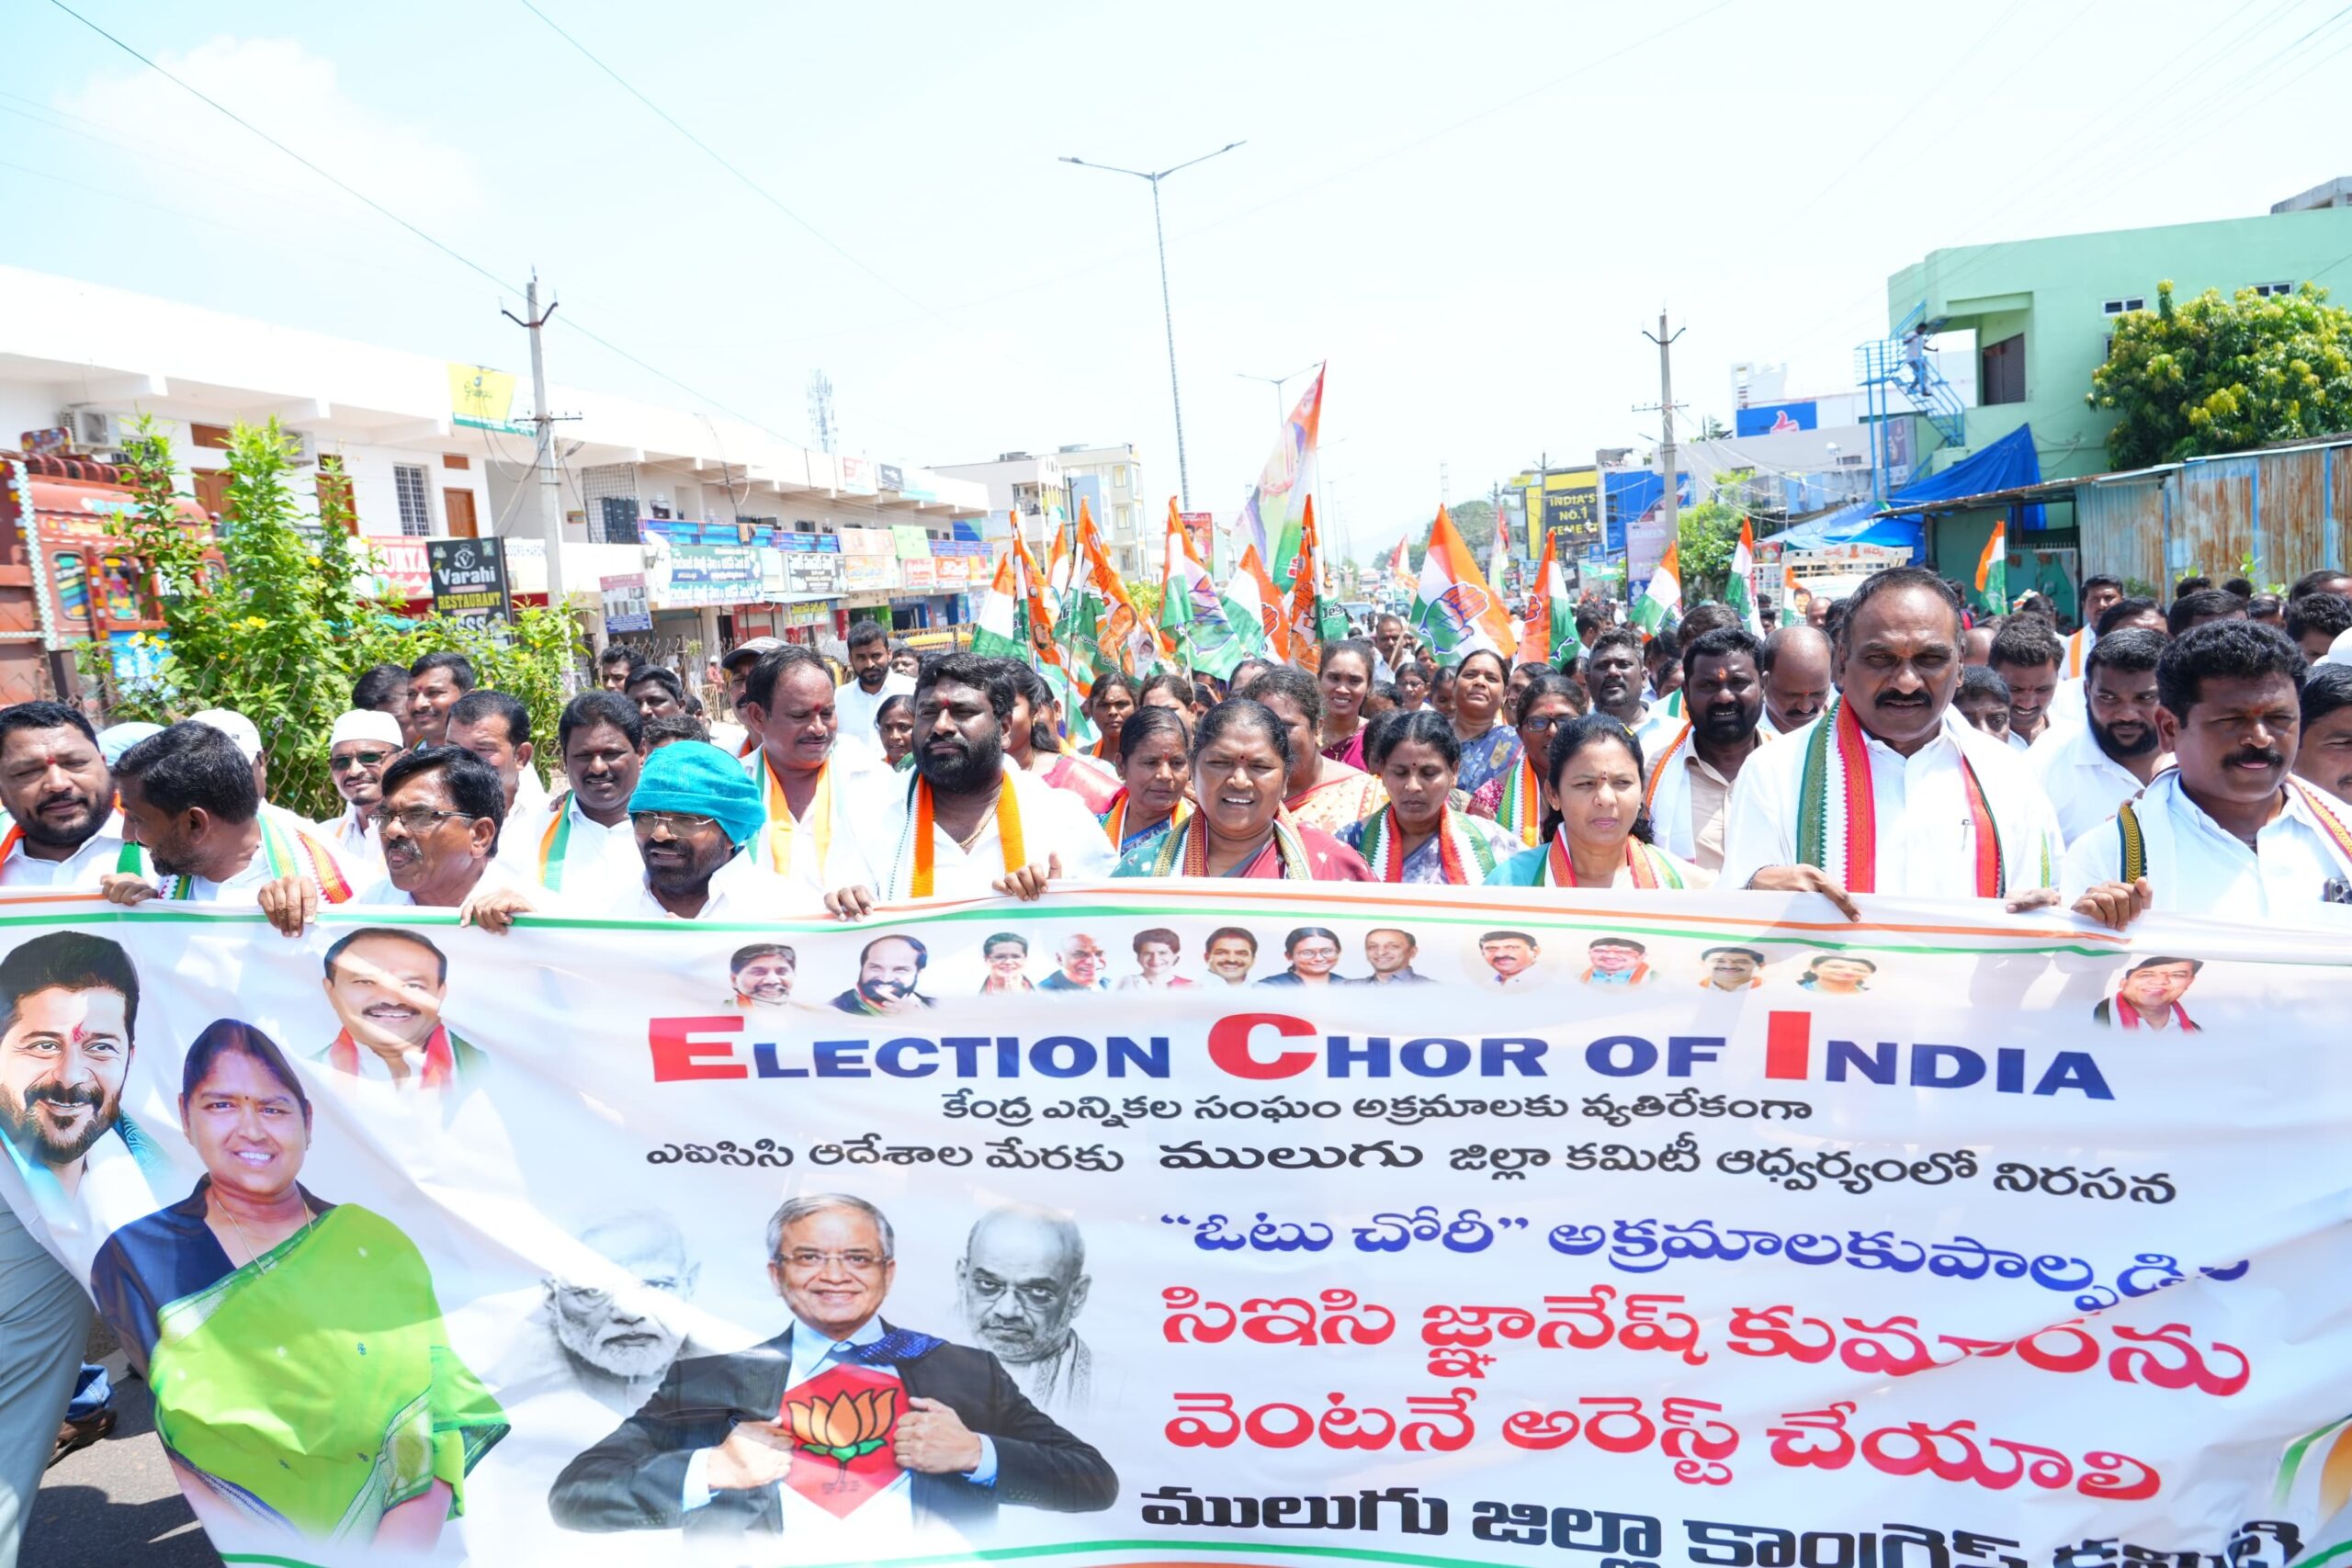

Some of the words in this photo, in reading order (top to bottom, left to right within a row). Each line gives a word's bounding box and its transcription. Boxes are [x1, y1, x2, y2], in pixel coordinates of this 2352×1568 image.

[1550, 493, 1596, 506] INDIA'S
[1559, 506, 1588, 521] NO.1
[438, 566, 496, 585] Varahi
[437, 592, 501, 610] RESTAURANT
[650, 1015, 1170, 1082] ELECTION
[1208, 1012, 1549, 1080] CHOR
[1586, 1036, 1725, 1077] OF
[1765, 1010, 2116, 1100] INDIA
[942, 1088, 1034, 1126] కేంద్ర
[1043, 1095, 1182, 1129] ఎన్నికల
[1194, 1094, 1341, 1123] సంఘం
[1353, 1093, 1568, 1126] అక్రమాలకు
[1581, 1088, 1813, 1128] వ్యతిరేకంగా
[646, 1139, 794, 1168] ఎఐసిసి
[809, 1133, 973, 1167] ఆదేశాల
[986, 1136, 1124, 1172] మేరకు
[1159, 1140, 1423, 1169] ములుగు
[1449, 1144, 1551, 1180] జిల్లా
[1566, 1131, 1701, 1172] కమిటీ
[1716, 1147, 1978, 1194] ఆధ్వర్యంలో
[1993, 1162, 2177, 1204] నిరసన
[1161, 1286, 1396, 1346] సిఇసి
[1421, 1284, 1709, 1379] జ్ఞానేష్
[1165, 1387, 1477, 1451] వెంటనే
[1502, 1397, 1739, 1485] అరెస్ట్
[1767, 1401, 2161, 1501] చేయాలి
[1141, 1485, 1449, 1536] ములుగు
